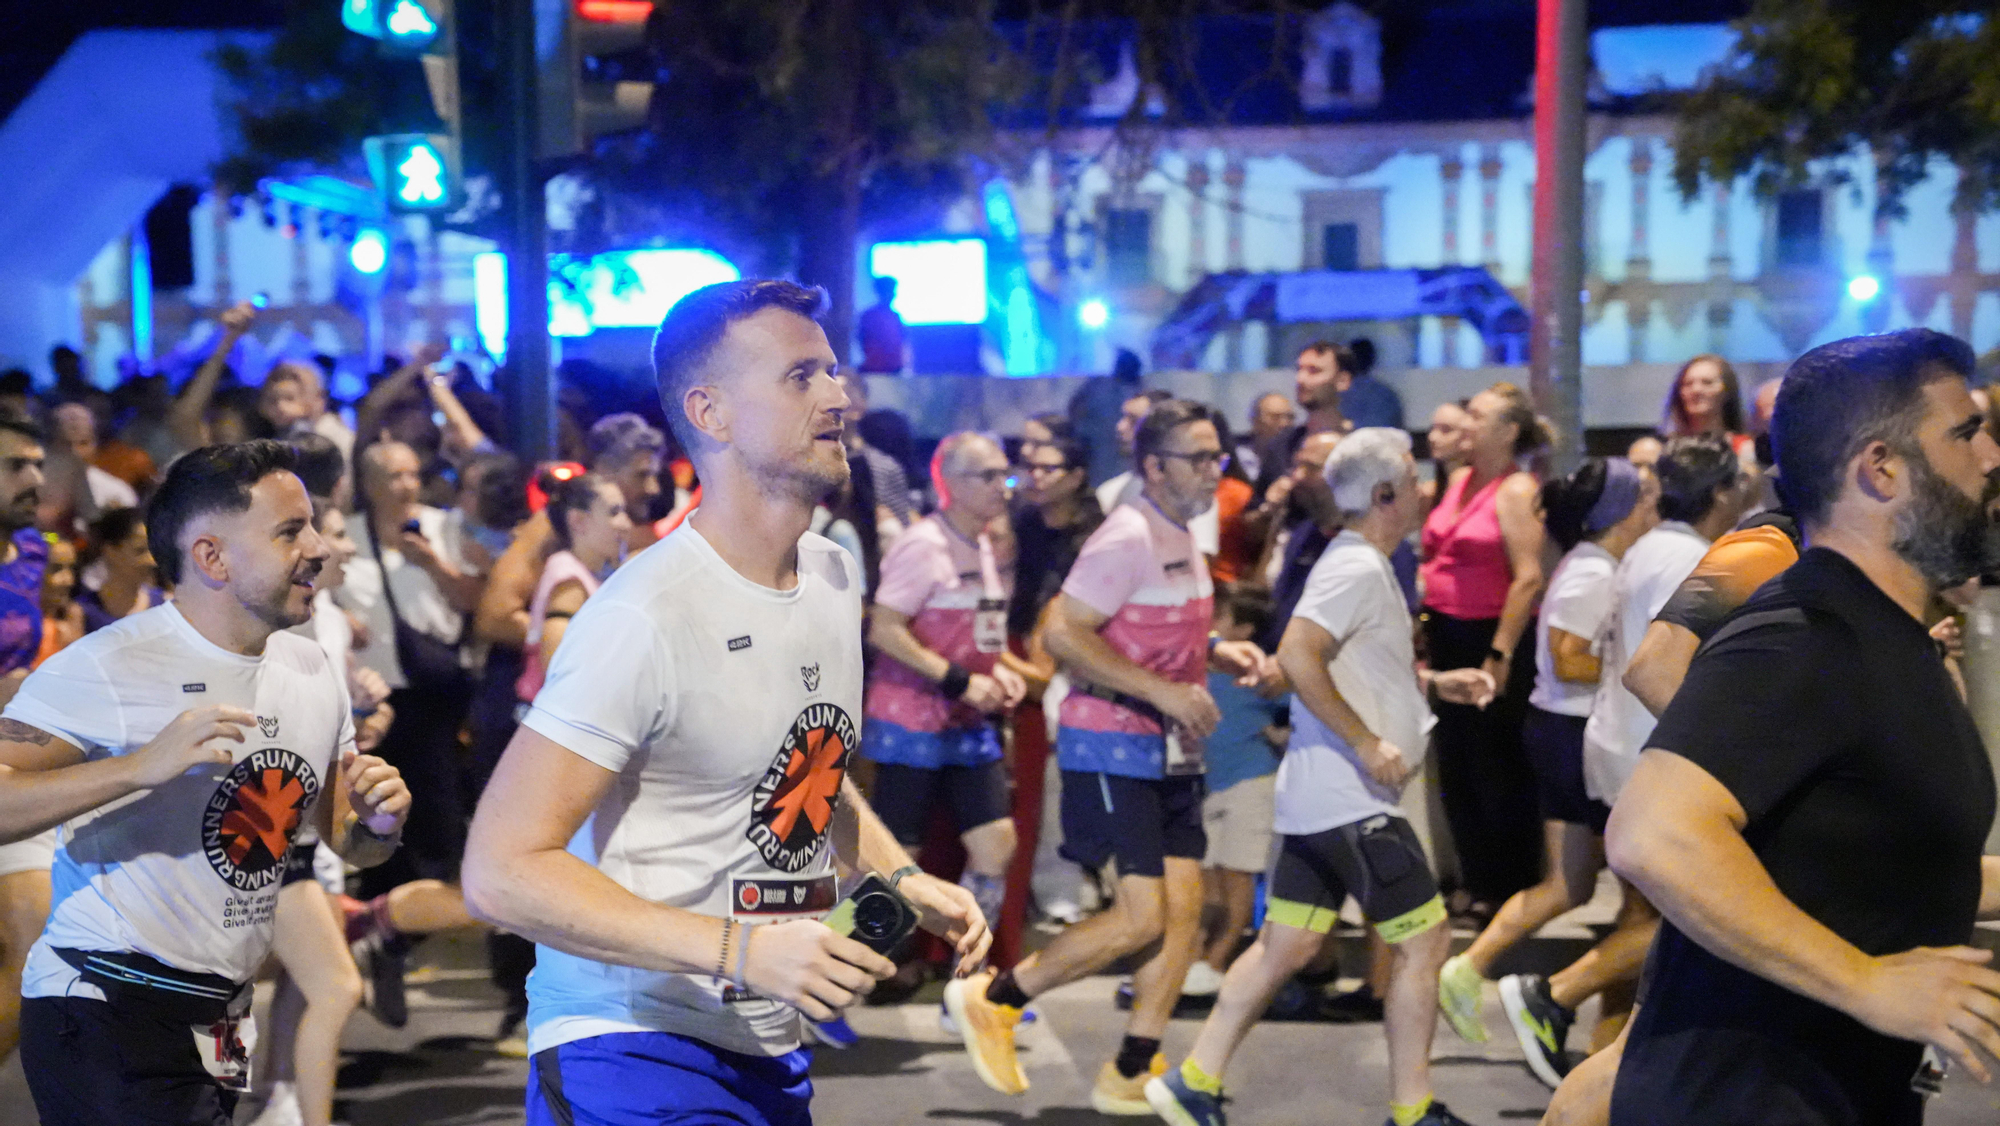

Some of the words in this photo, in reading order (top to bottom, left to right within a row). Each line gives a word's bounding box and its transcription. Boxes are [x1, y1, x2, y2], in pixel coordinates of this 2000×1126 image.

[256, 715, 279, 729] Rock
[204, 764, 250, 879] RUNNERS
[251, 749, 296, 772] RUN
[295, 761, 318, 808] ROC
[748, 733, 797, 861] RUNERS
[796, 705, 836, 736] RUN
[222, 918, 246, 929] Give
